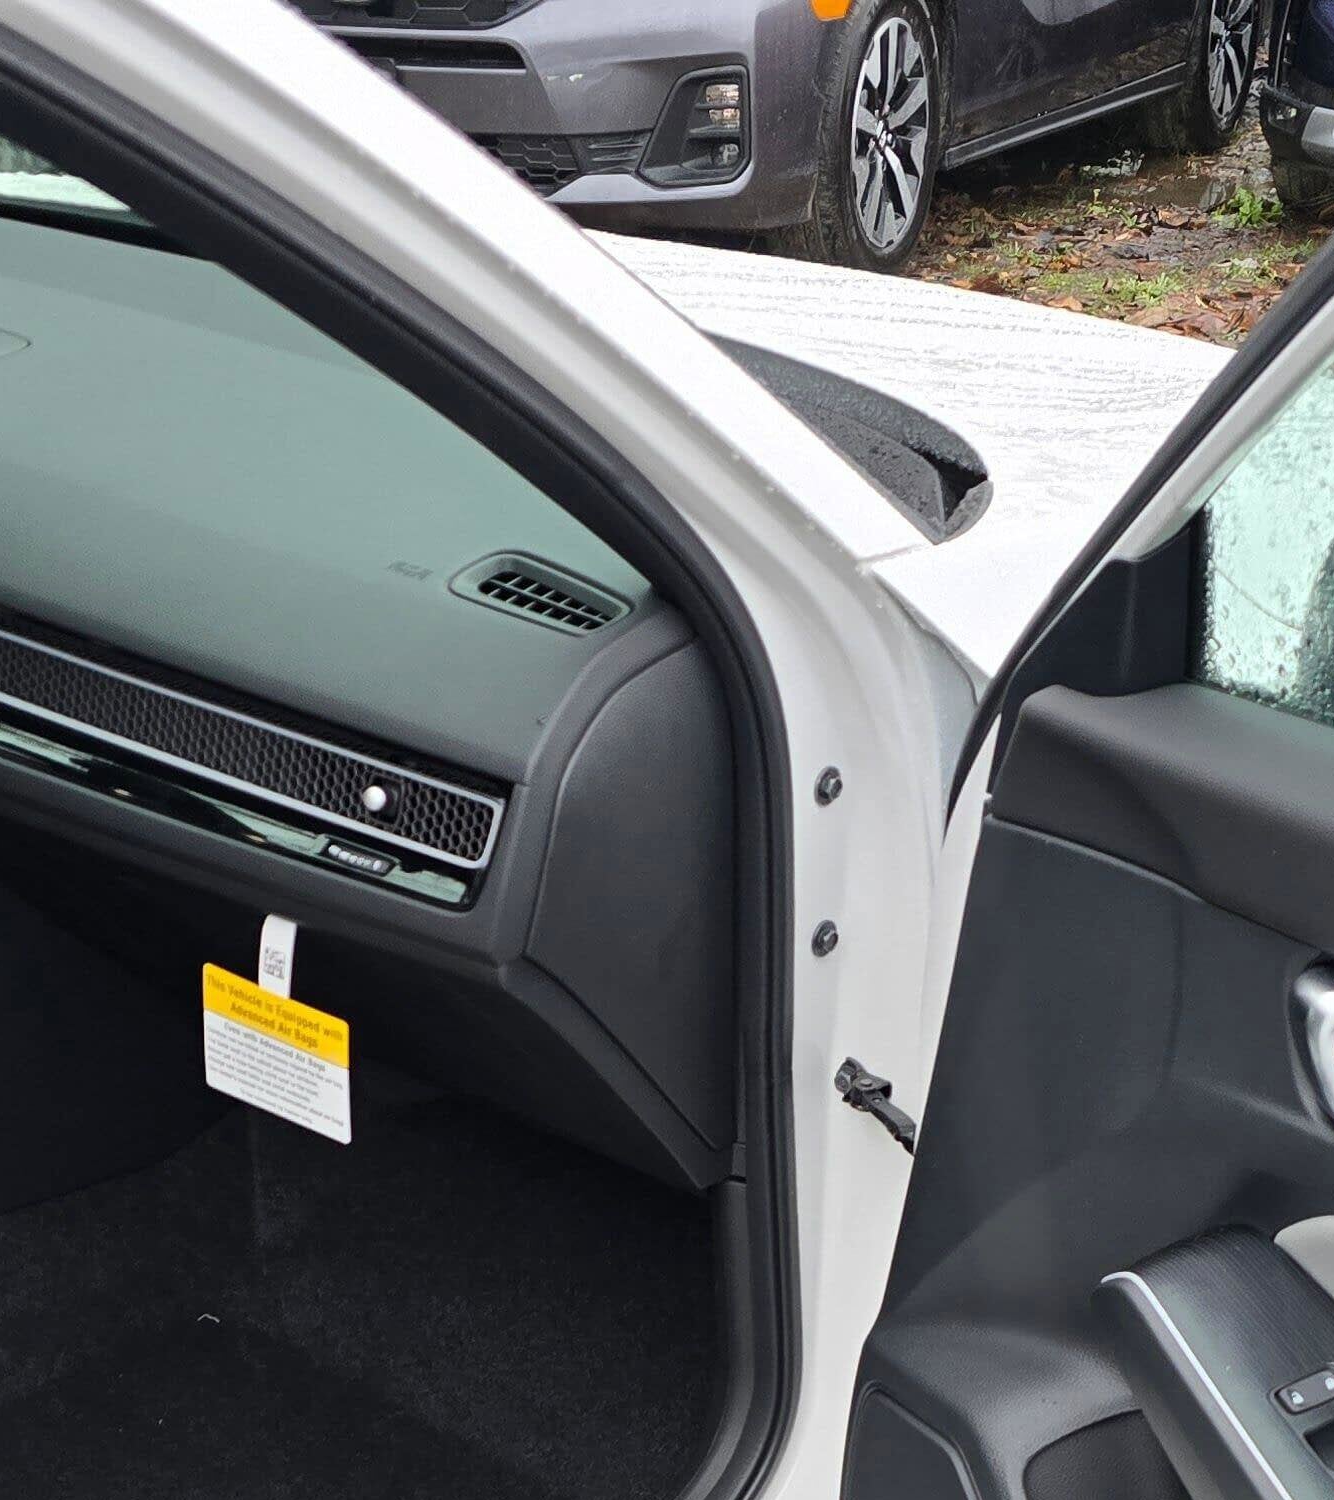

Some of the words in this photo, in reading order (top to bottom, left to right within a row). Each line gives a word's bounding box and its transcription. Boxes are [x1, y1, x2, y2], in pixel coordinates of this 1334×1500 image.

[229, 985, 262, 1007] Vehicle
[276, 1005, 319, 1032] Equipped
[230, 1002, 275, 1030] Advanced
[278, 1024, 291, 1036] Air
[294, 1028, 318, 1048] Bags
